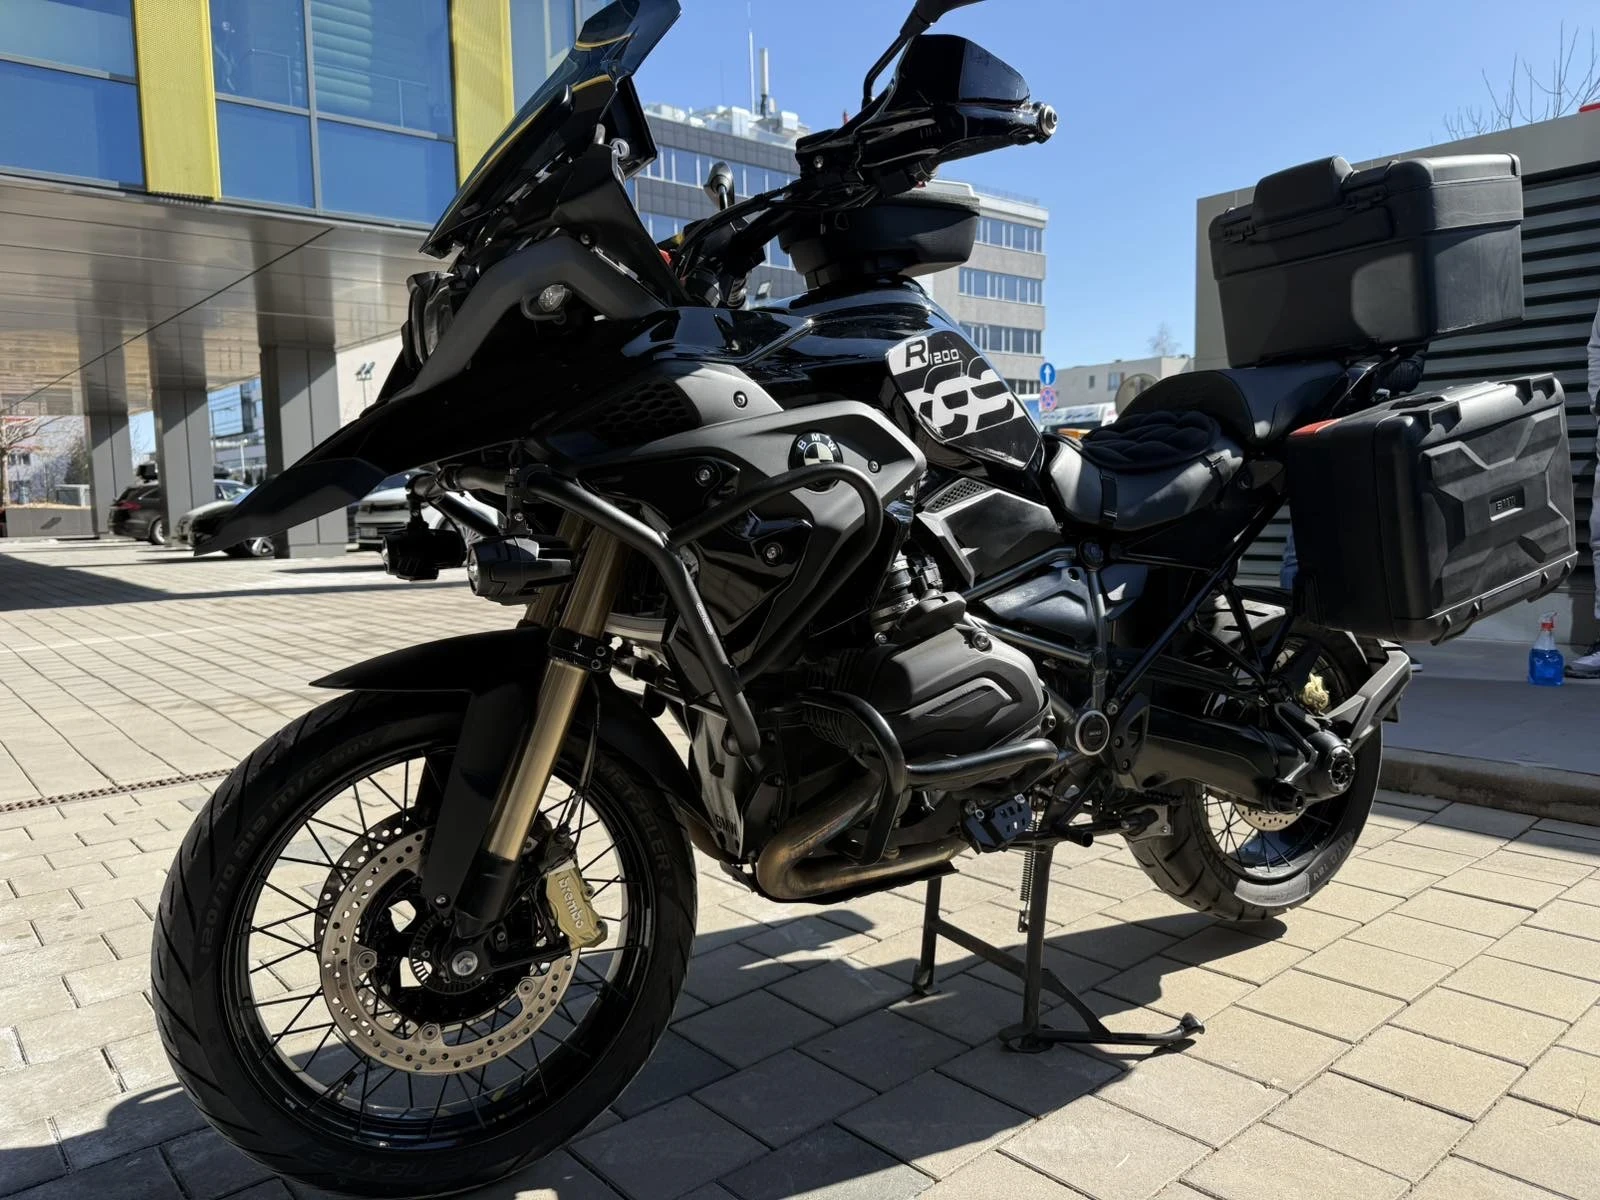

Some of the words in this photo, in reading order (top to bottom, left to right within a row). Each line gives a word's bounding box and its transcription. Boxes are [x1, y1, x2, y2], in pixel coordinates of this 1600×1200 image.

[905, 339, 926, 368] R
[929, 348, 960, 365] 1200
[797, 432, 836, 450] BMW
[559, 875, 584, 929] brembo
